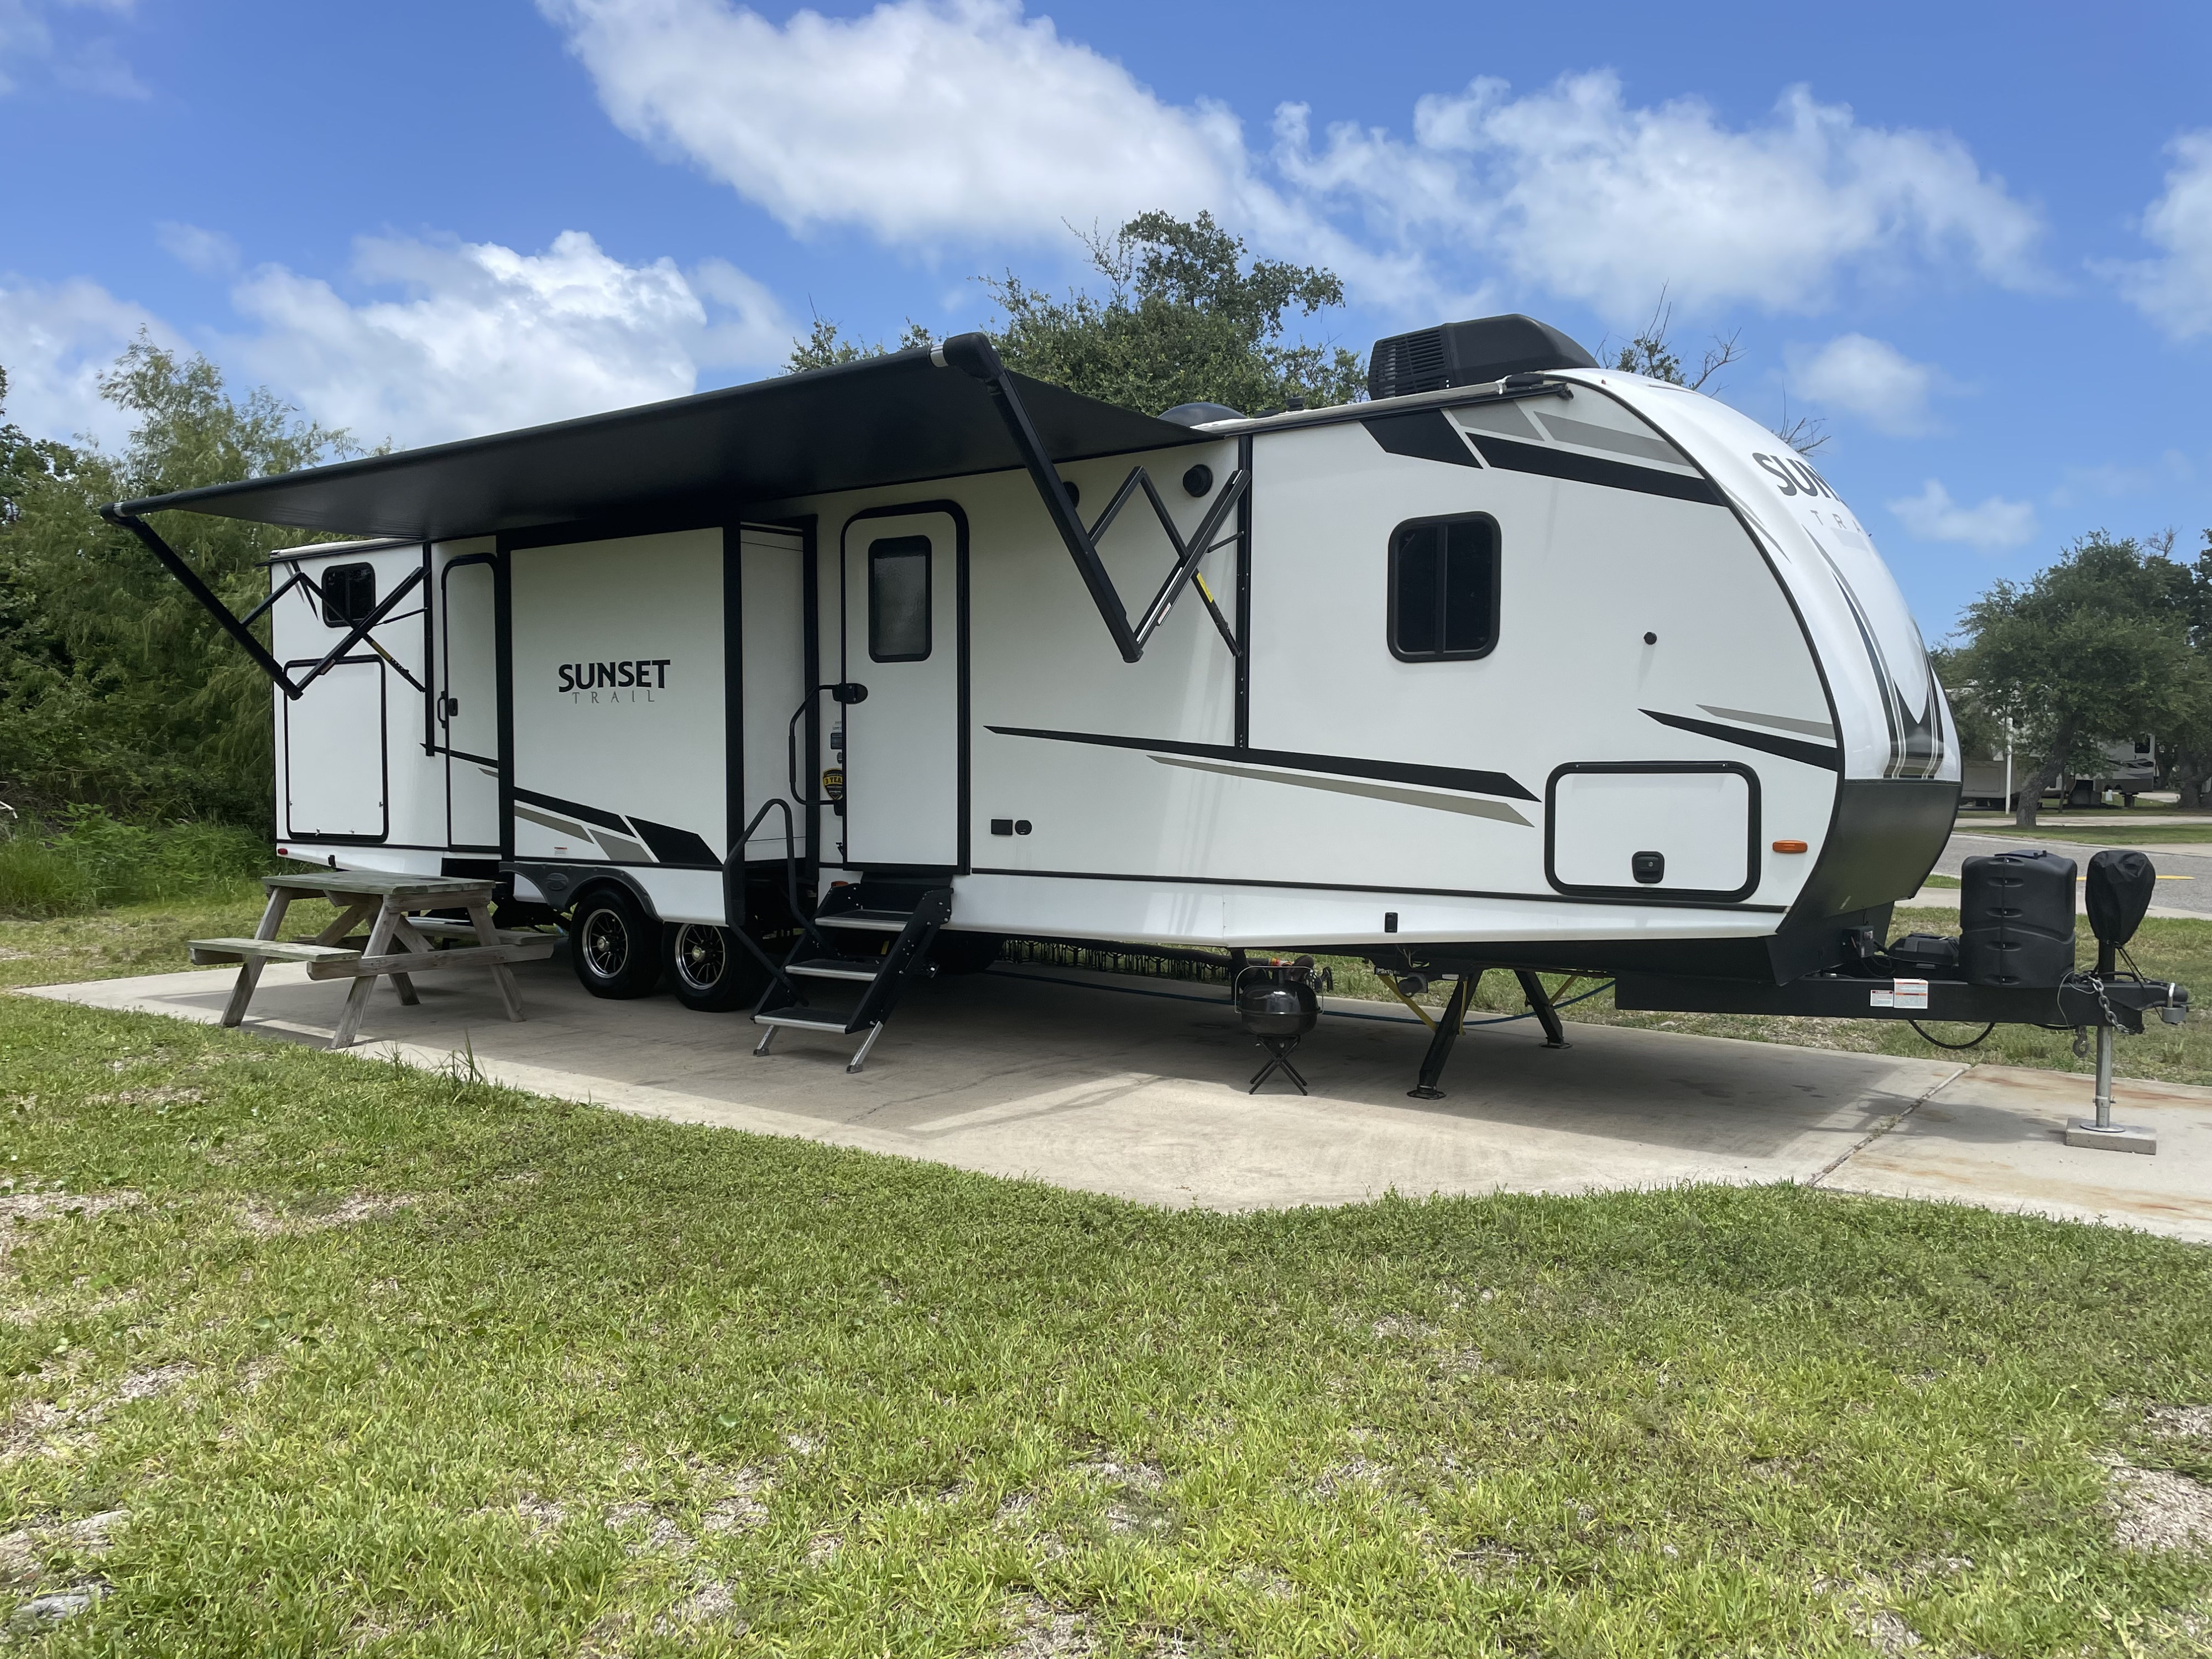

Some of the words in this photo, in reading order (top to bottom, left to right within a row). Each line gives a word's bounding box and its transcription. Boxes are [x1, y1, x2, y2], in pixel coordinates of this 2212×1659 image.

[1752, 452, 1849, 509] SUN
[1810, 509, 1864, 535] TRA
[559, 659, 670, 692] SUNSET
[572, 690, 655, 704] TRAIL
